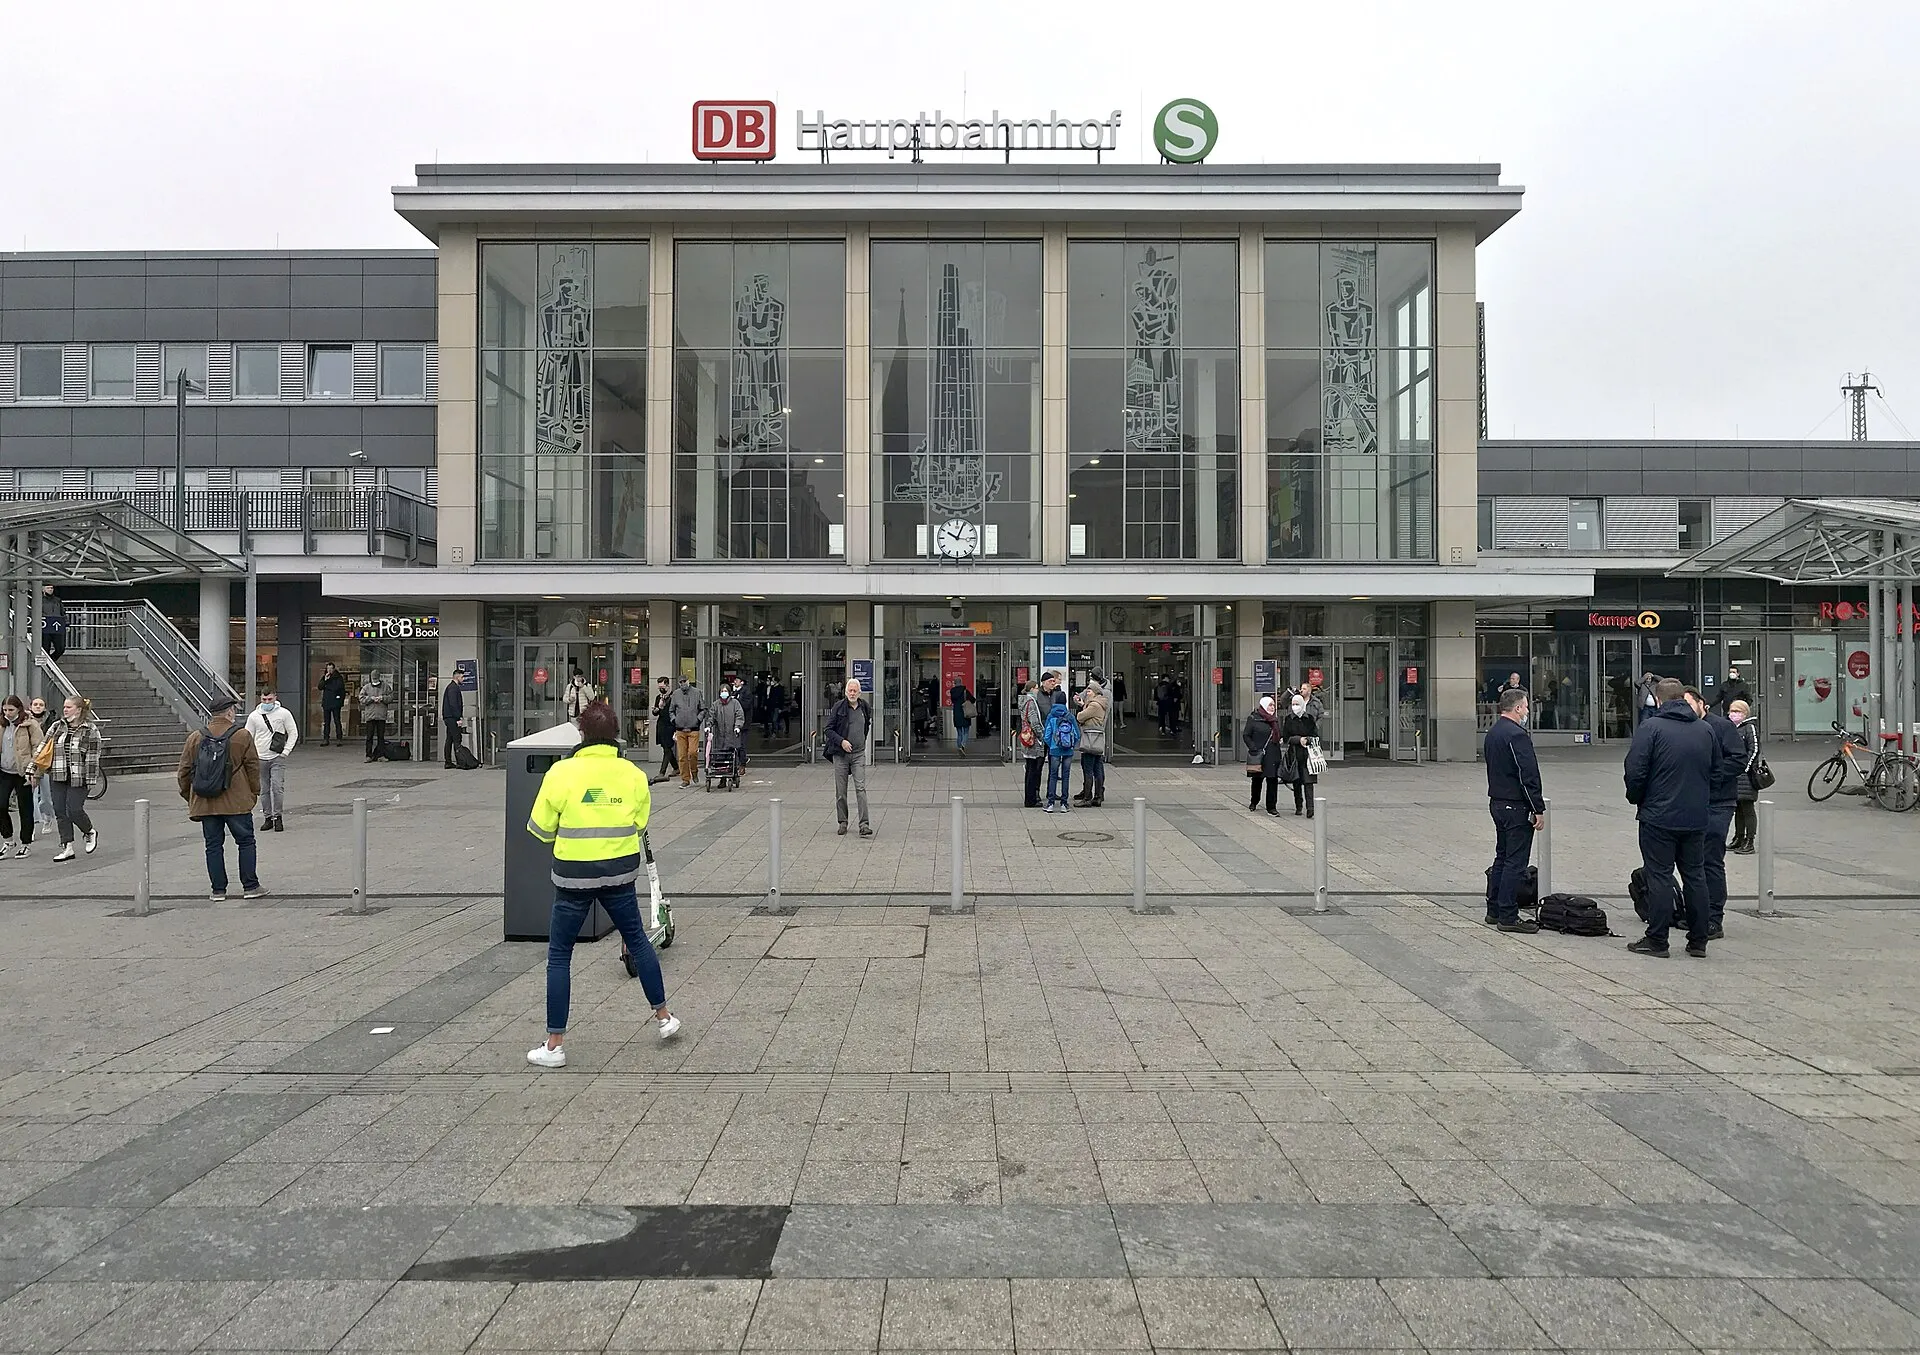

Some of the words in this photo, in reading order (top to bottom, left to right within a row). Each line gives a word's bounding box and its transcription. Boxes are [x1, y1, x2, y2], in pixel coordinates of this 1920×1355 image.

[703, 109, 765, 149] DB
[796, 109, 1122, 158] Hauptbahnhof
[1164, 103, 1208, 157] S
[348, 618, 372, 628] Press
[1588, 613, 1637, 629] Kamps
